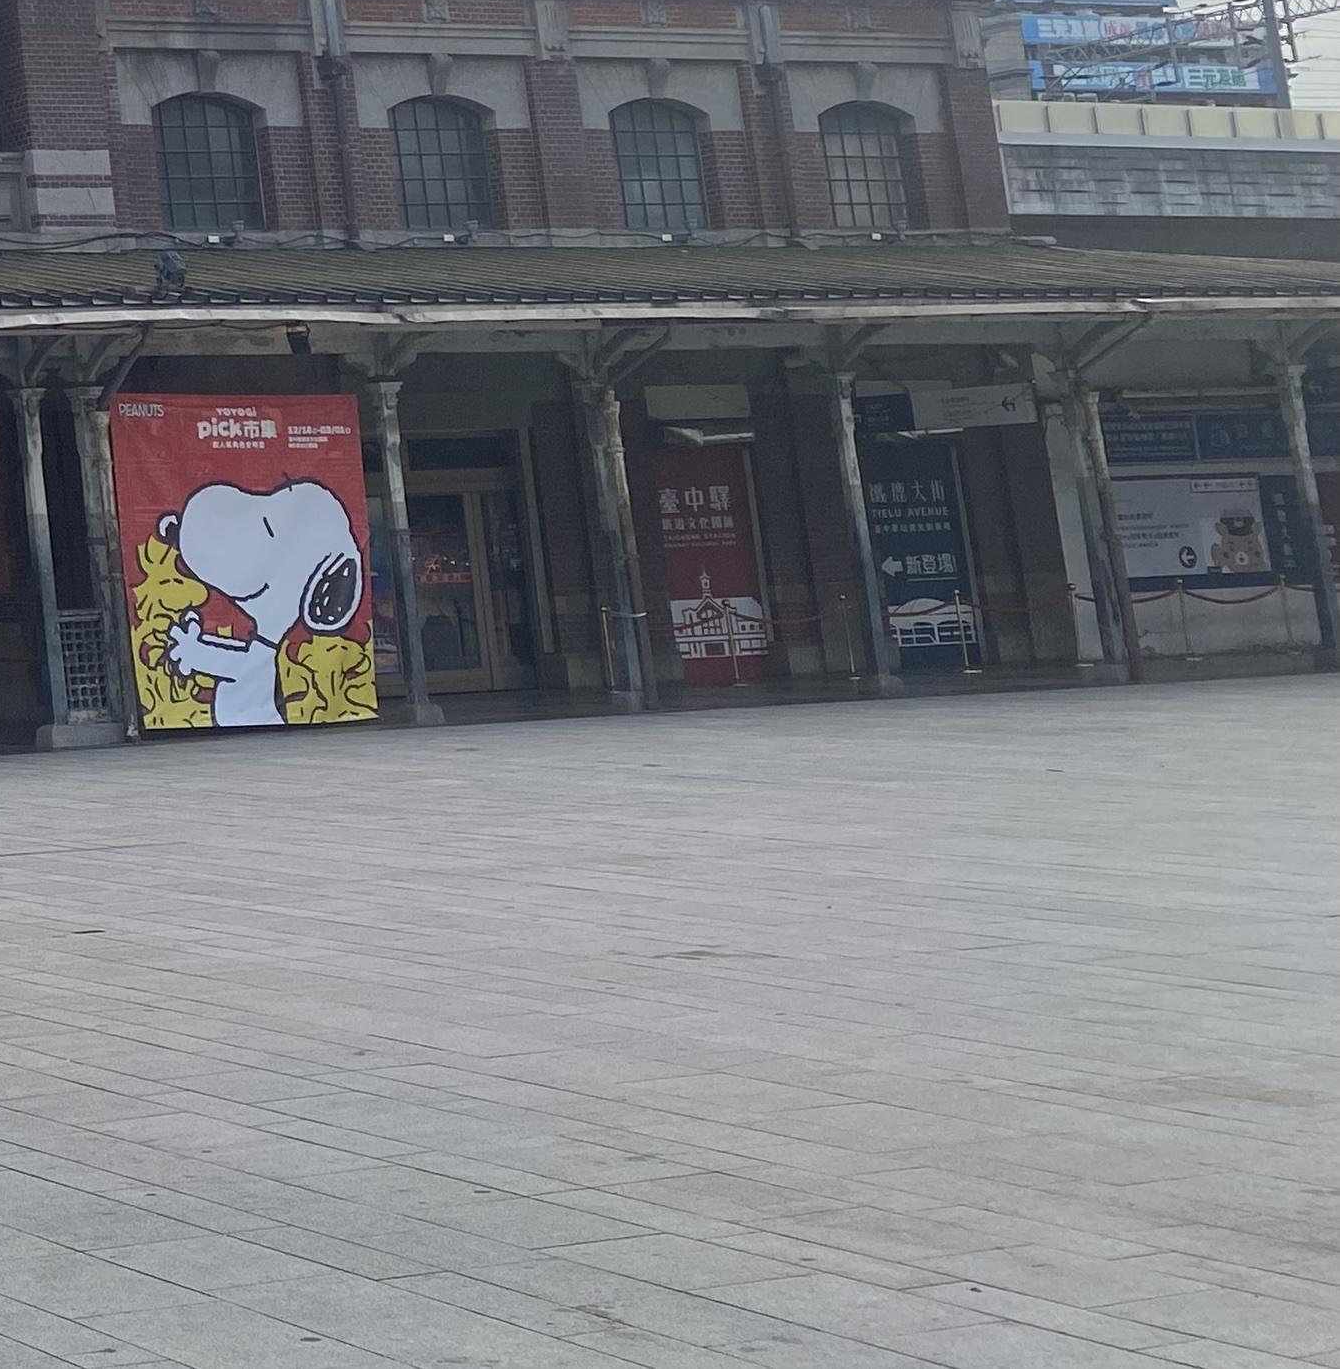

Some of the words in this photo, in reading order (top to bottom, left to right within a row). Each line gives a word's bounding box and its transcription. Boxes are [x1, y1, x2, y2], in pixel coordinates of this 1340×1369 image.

[119, 403, 164, 417] PEANUTS
[657, 485, 730, 514] 臺中驛
[907, 506, 949, 517] AVENUE
